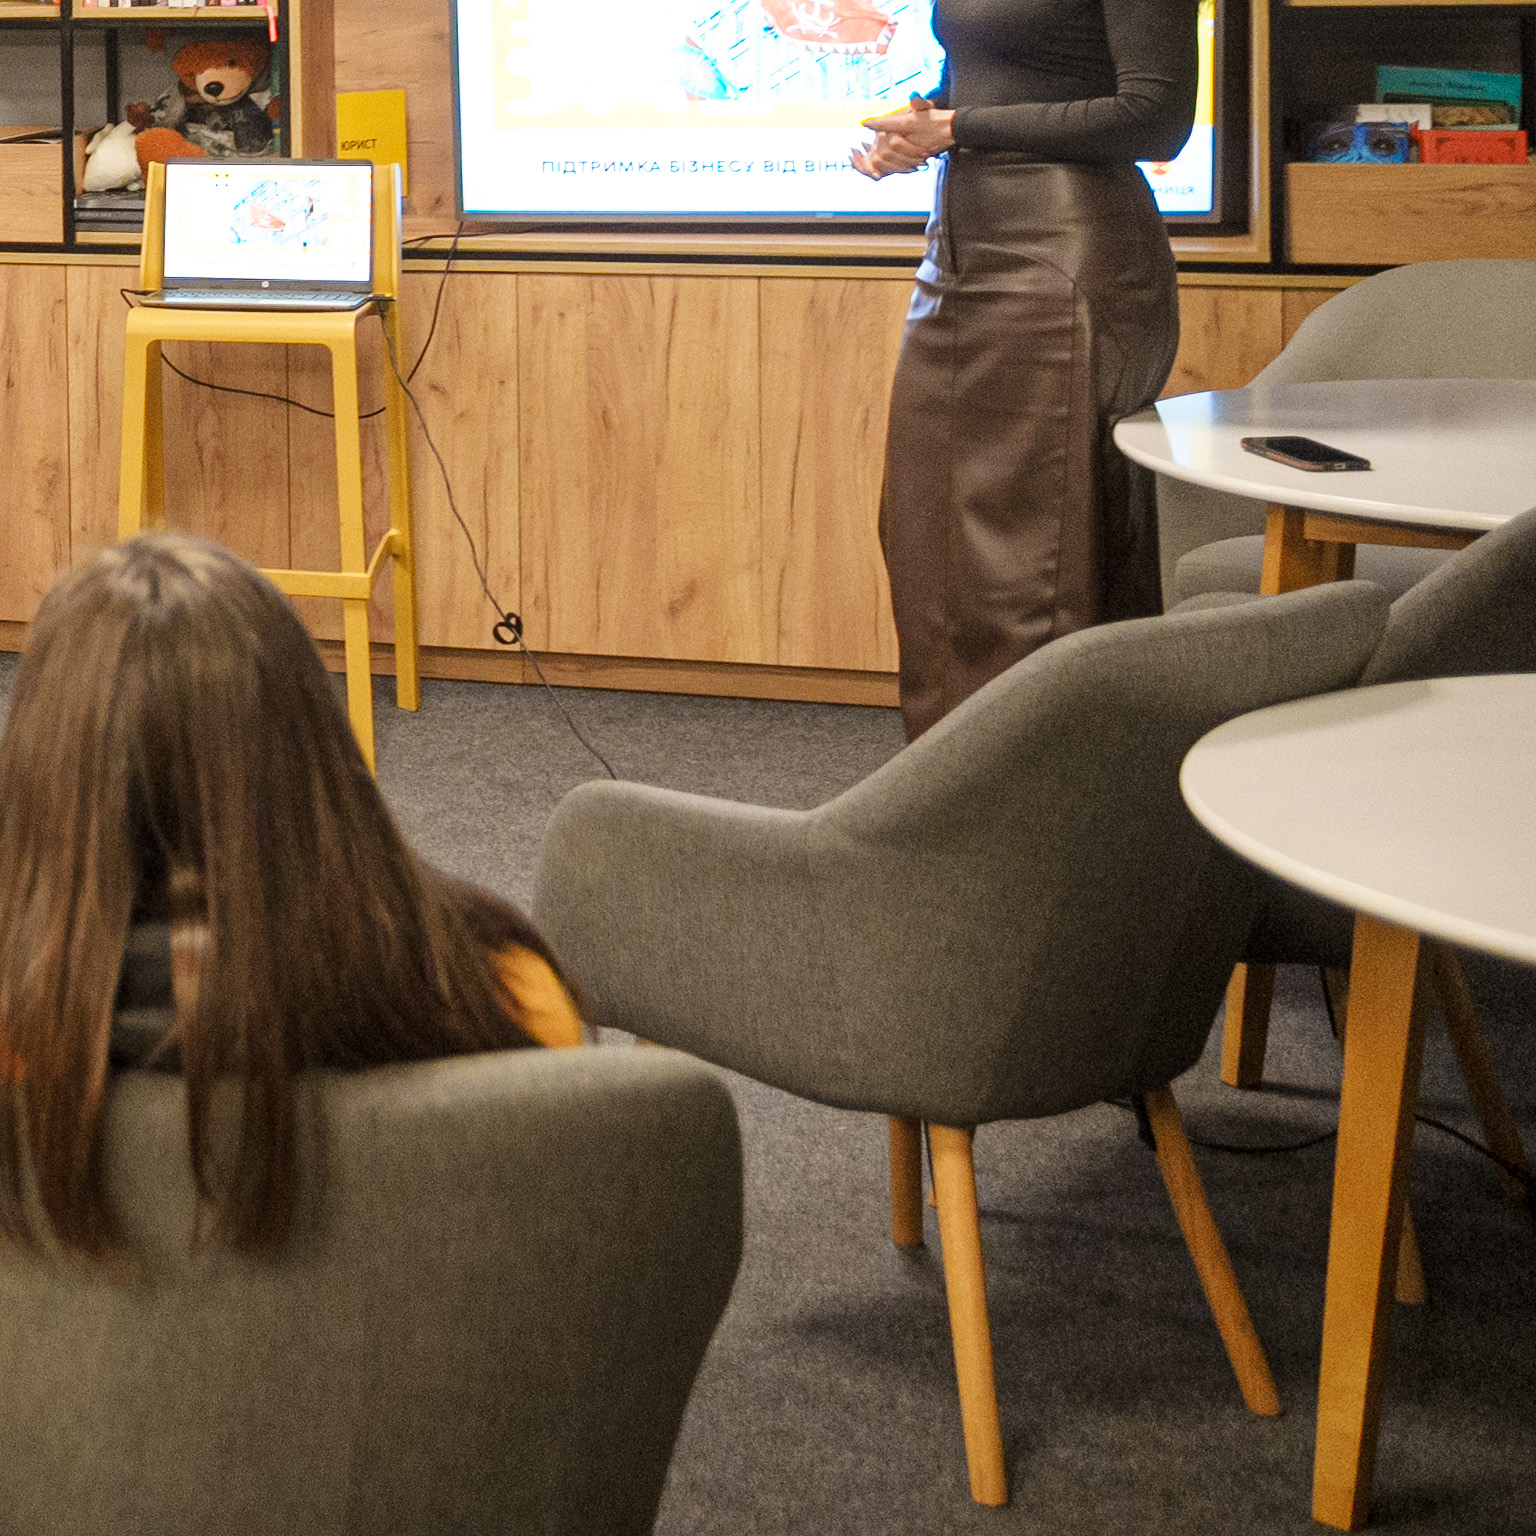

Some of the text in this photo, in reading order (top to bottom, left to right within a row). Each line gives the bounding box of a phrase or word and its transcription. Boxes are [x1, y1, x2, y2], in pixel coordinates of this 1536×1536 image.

[341, 138, 377, 151] ЮРИСТ
[541, 160, 662, 175] ПІДТРИМКА
[670, 160, 755, 174] БІЗНЕСУ
[763, 160, 797, 175] ВІД
